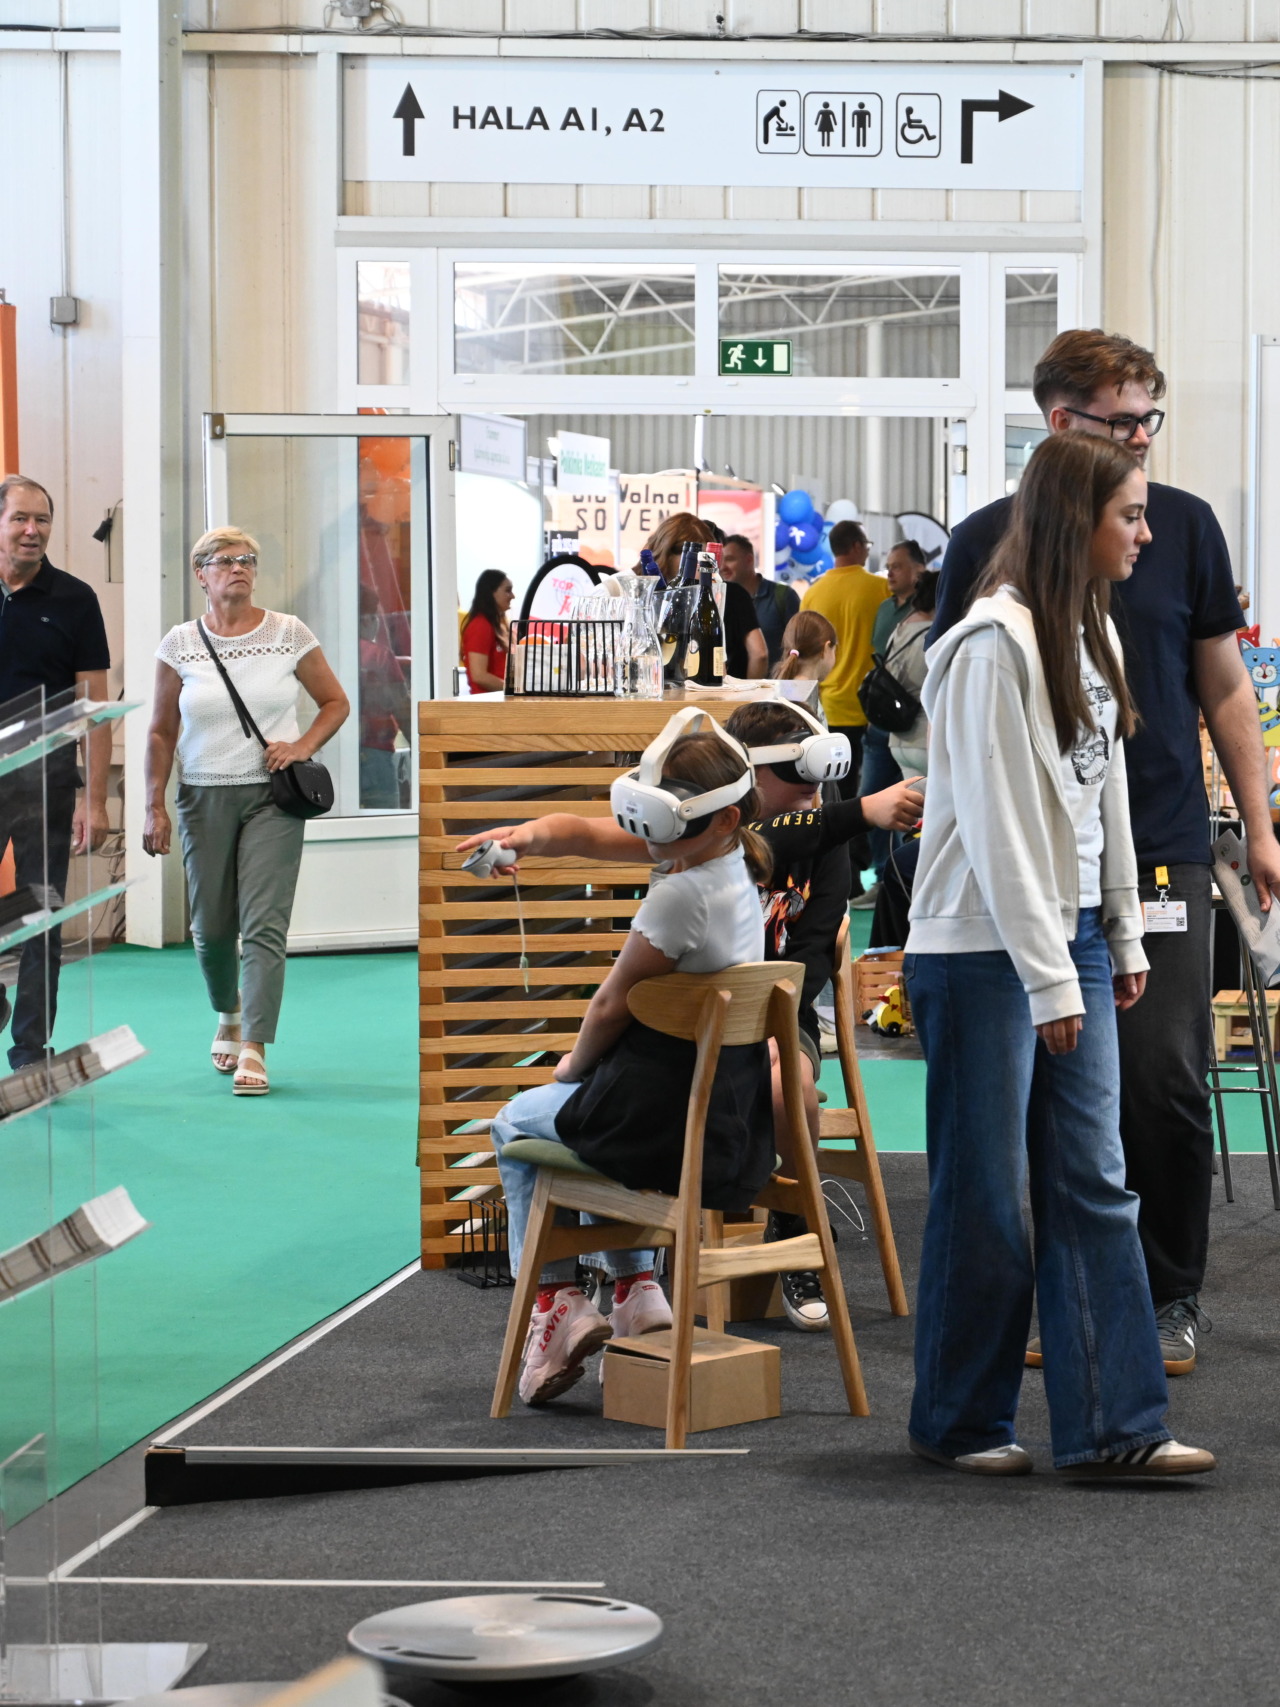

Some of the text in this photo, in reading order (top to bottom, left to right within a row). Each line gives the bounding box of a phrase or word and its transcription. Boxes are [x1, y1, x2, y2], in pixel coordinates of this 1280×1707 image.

[452, 105, 665, 137] HALA A1, A2
